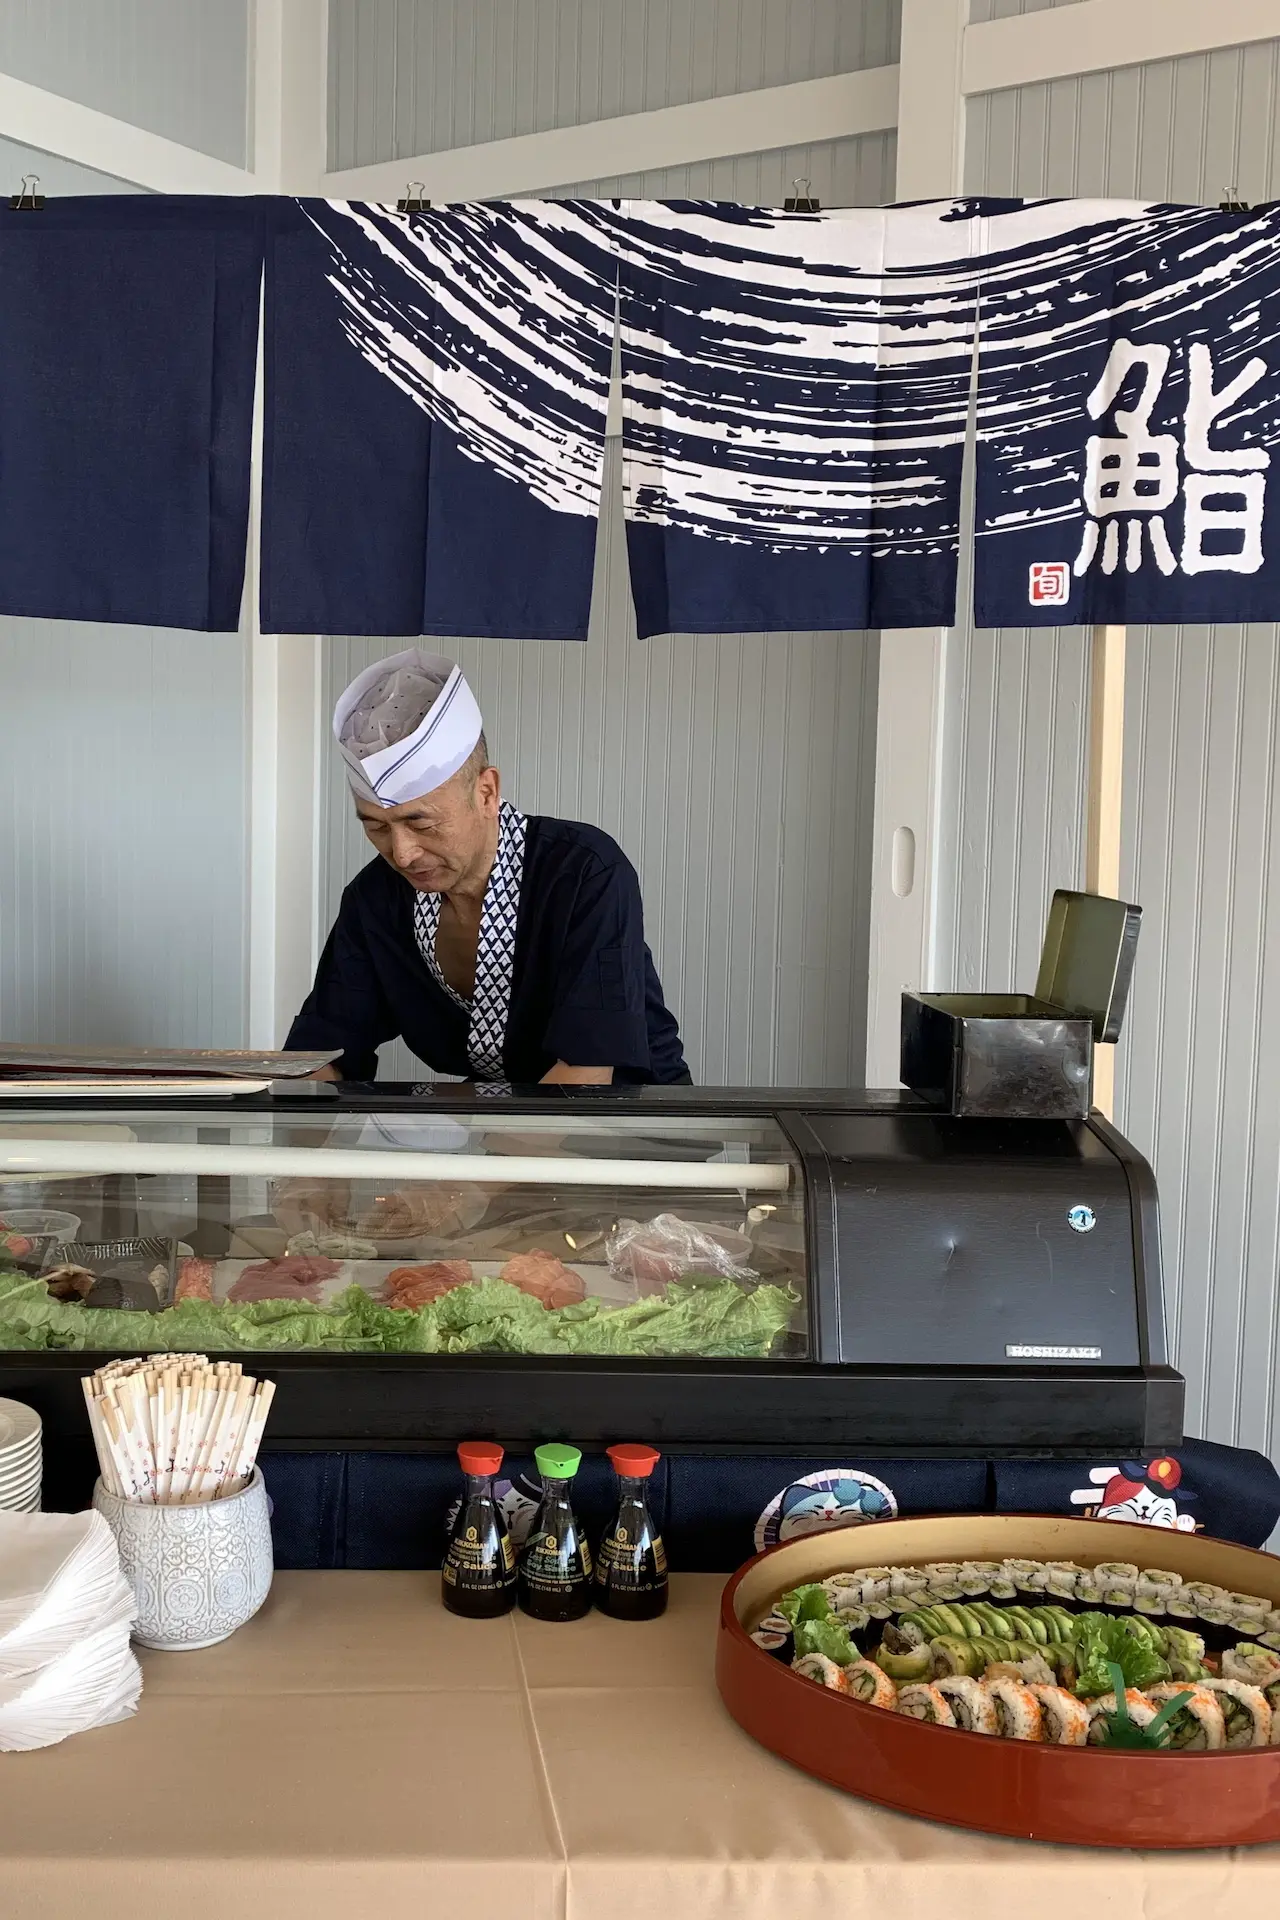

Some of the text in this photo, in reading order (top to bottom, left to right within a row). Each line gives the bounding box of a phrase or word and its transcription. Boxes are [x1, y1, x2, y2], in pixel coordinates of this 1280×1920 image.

[1073, 338, 1271, 576] 鮨
[1010, 1346, 1098, 1359] HOSHIZAKI
[447, 1554, 498, 1571] Soy Sauce
